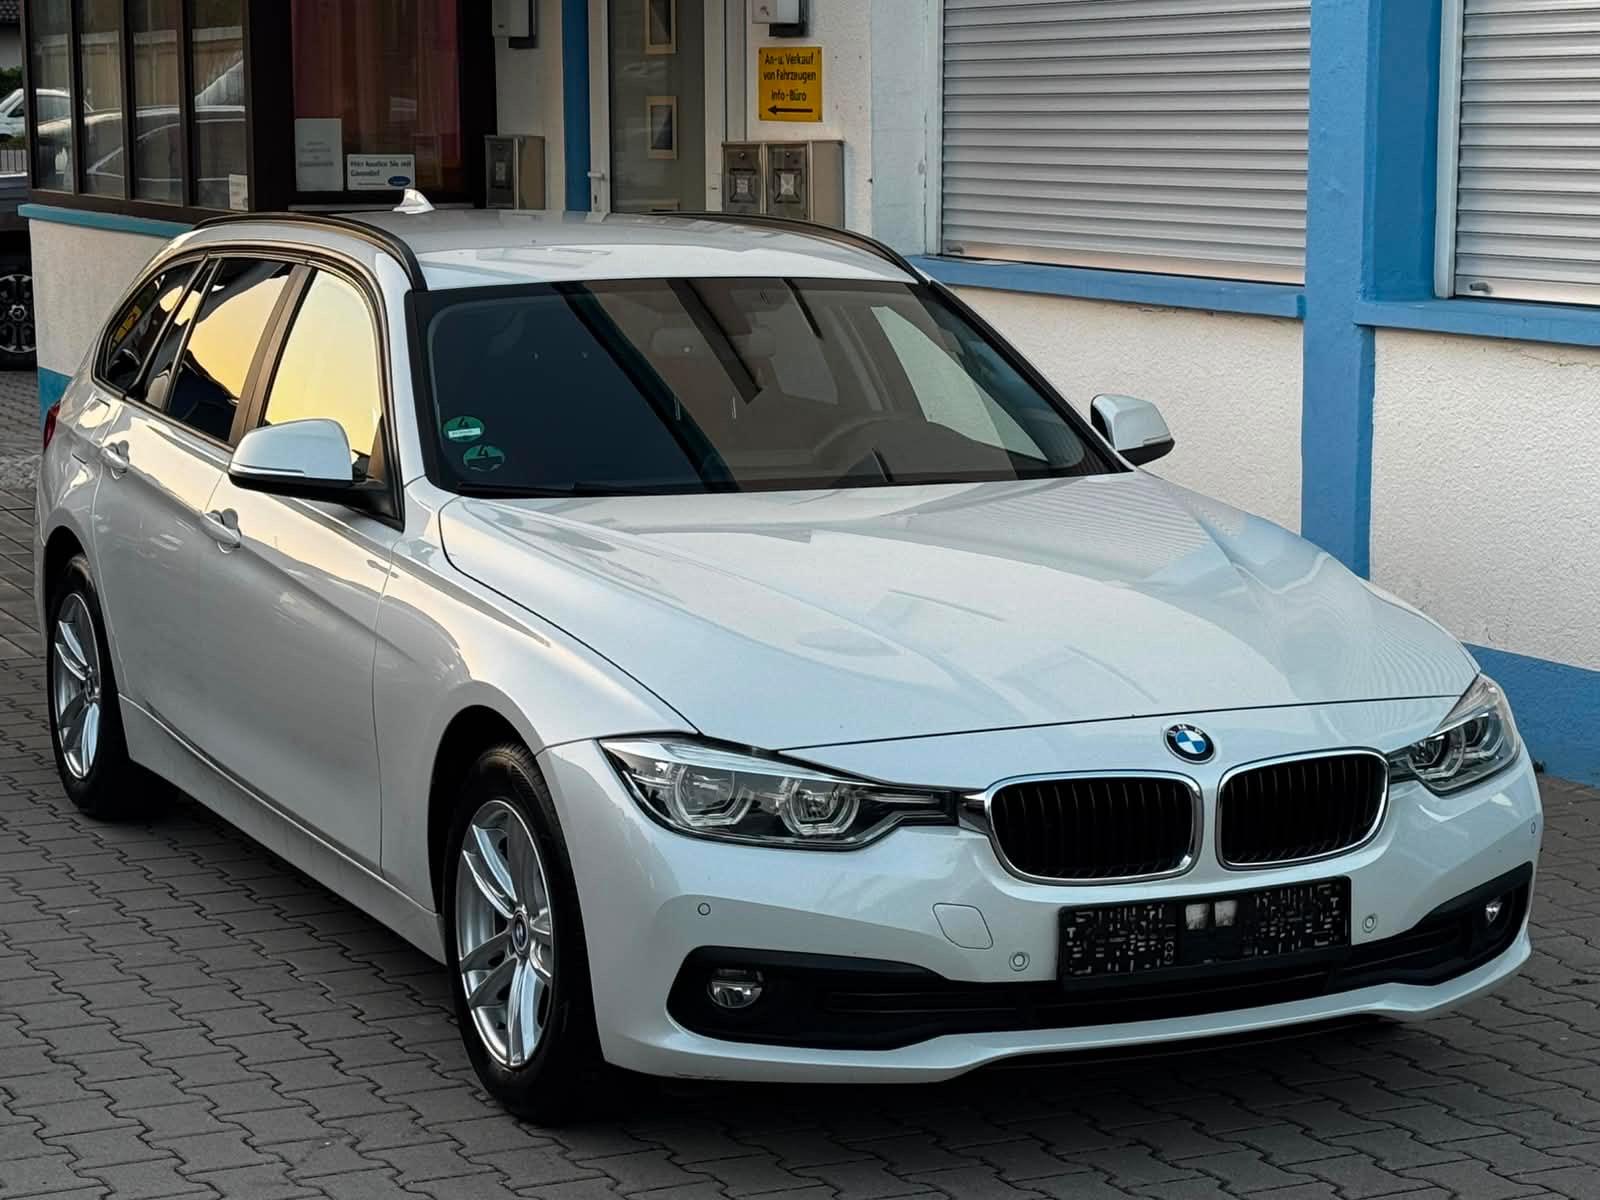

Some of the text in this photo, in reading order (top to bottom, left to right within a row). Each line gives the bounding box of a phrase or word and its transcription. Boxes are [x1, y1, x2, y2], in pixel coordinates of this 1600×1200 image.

[785, 52, 814, 65] Verkauf
[763, 69, 817, 84] von Fahrzeugen
[1167, 724, 1204, 736] BMW
